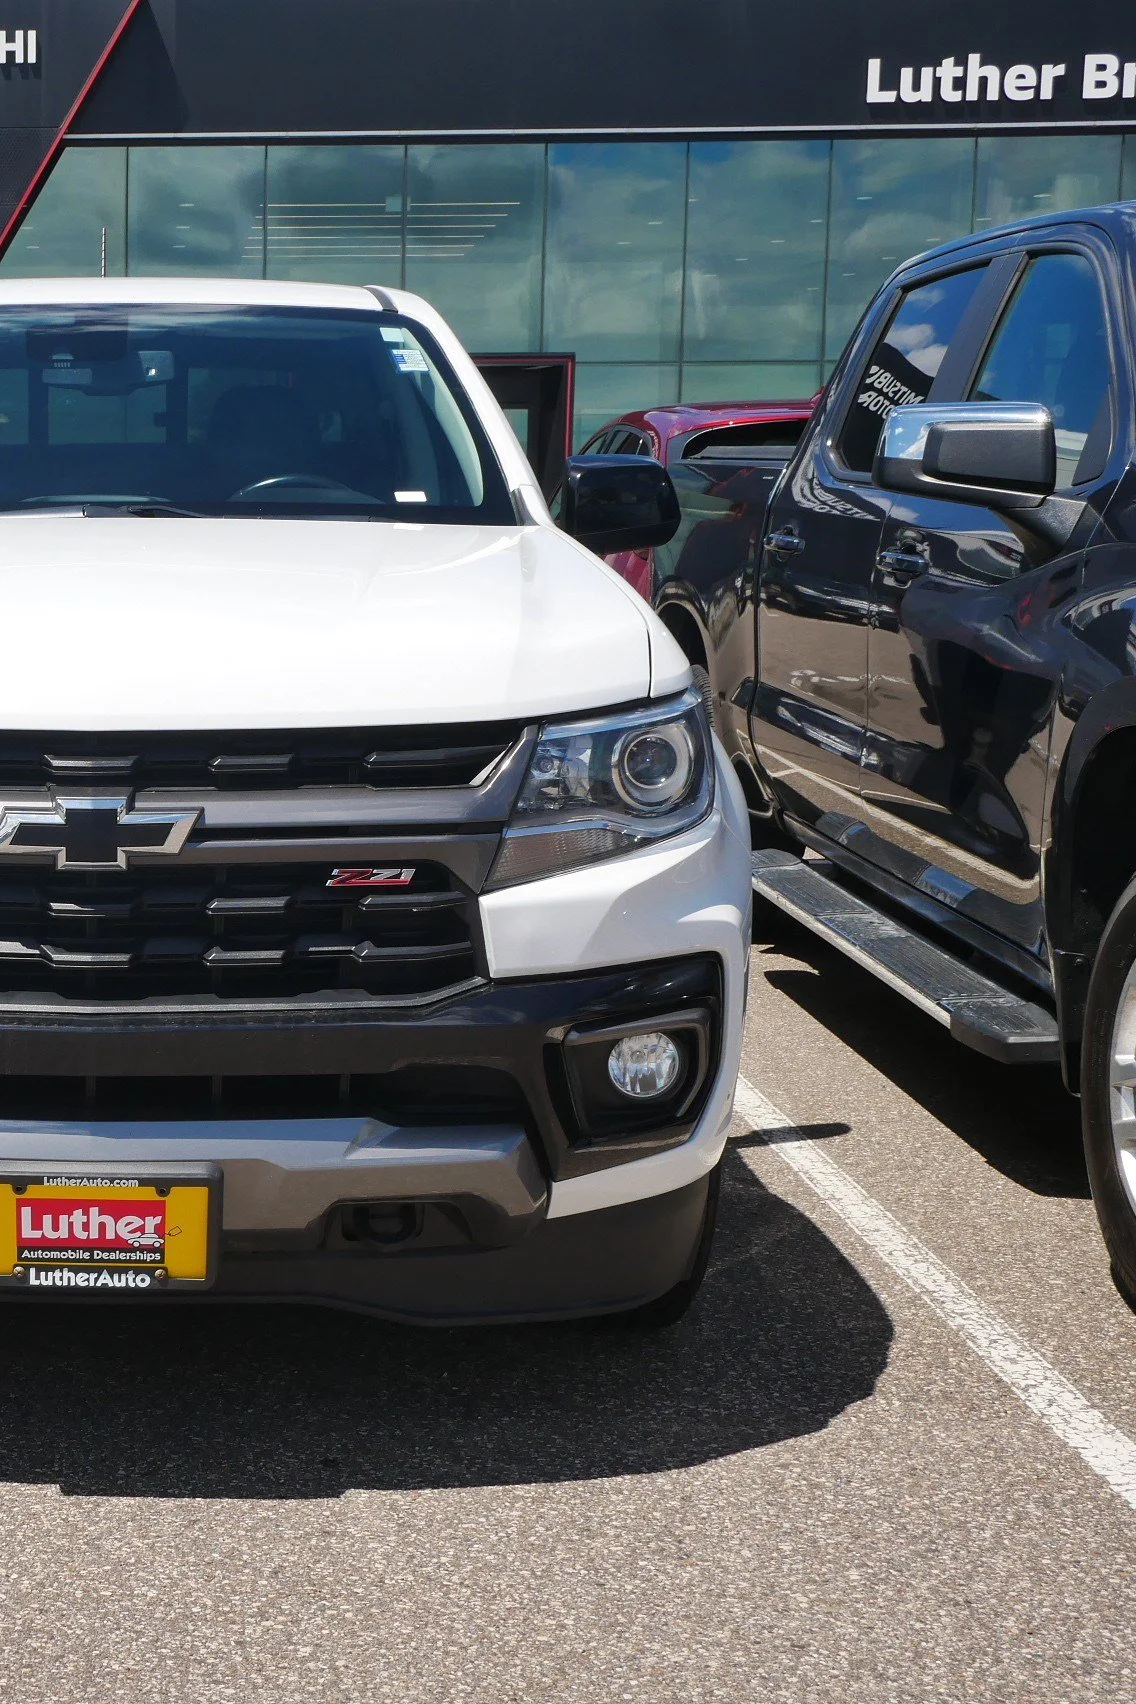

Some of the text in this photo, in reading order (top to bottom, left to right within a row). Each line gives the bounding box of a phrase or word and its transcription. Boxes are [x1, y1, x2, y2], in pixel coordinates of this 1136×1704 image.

[865, 52, 1066, 103] Luther
[325, 868, 416, 887] Z71
[43, 1176, 139, 1188] LutherAuto.com
[20, 1206, 163, 1241] Luther
[21, 1249, 161, 1262] Automobile Dealerships
[29, 1267, 151, 1288] LutherAuto
